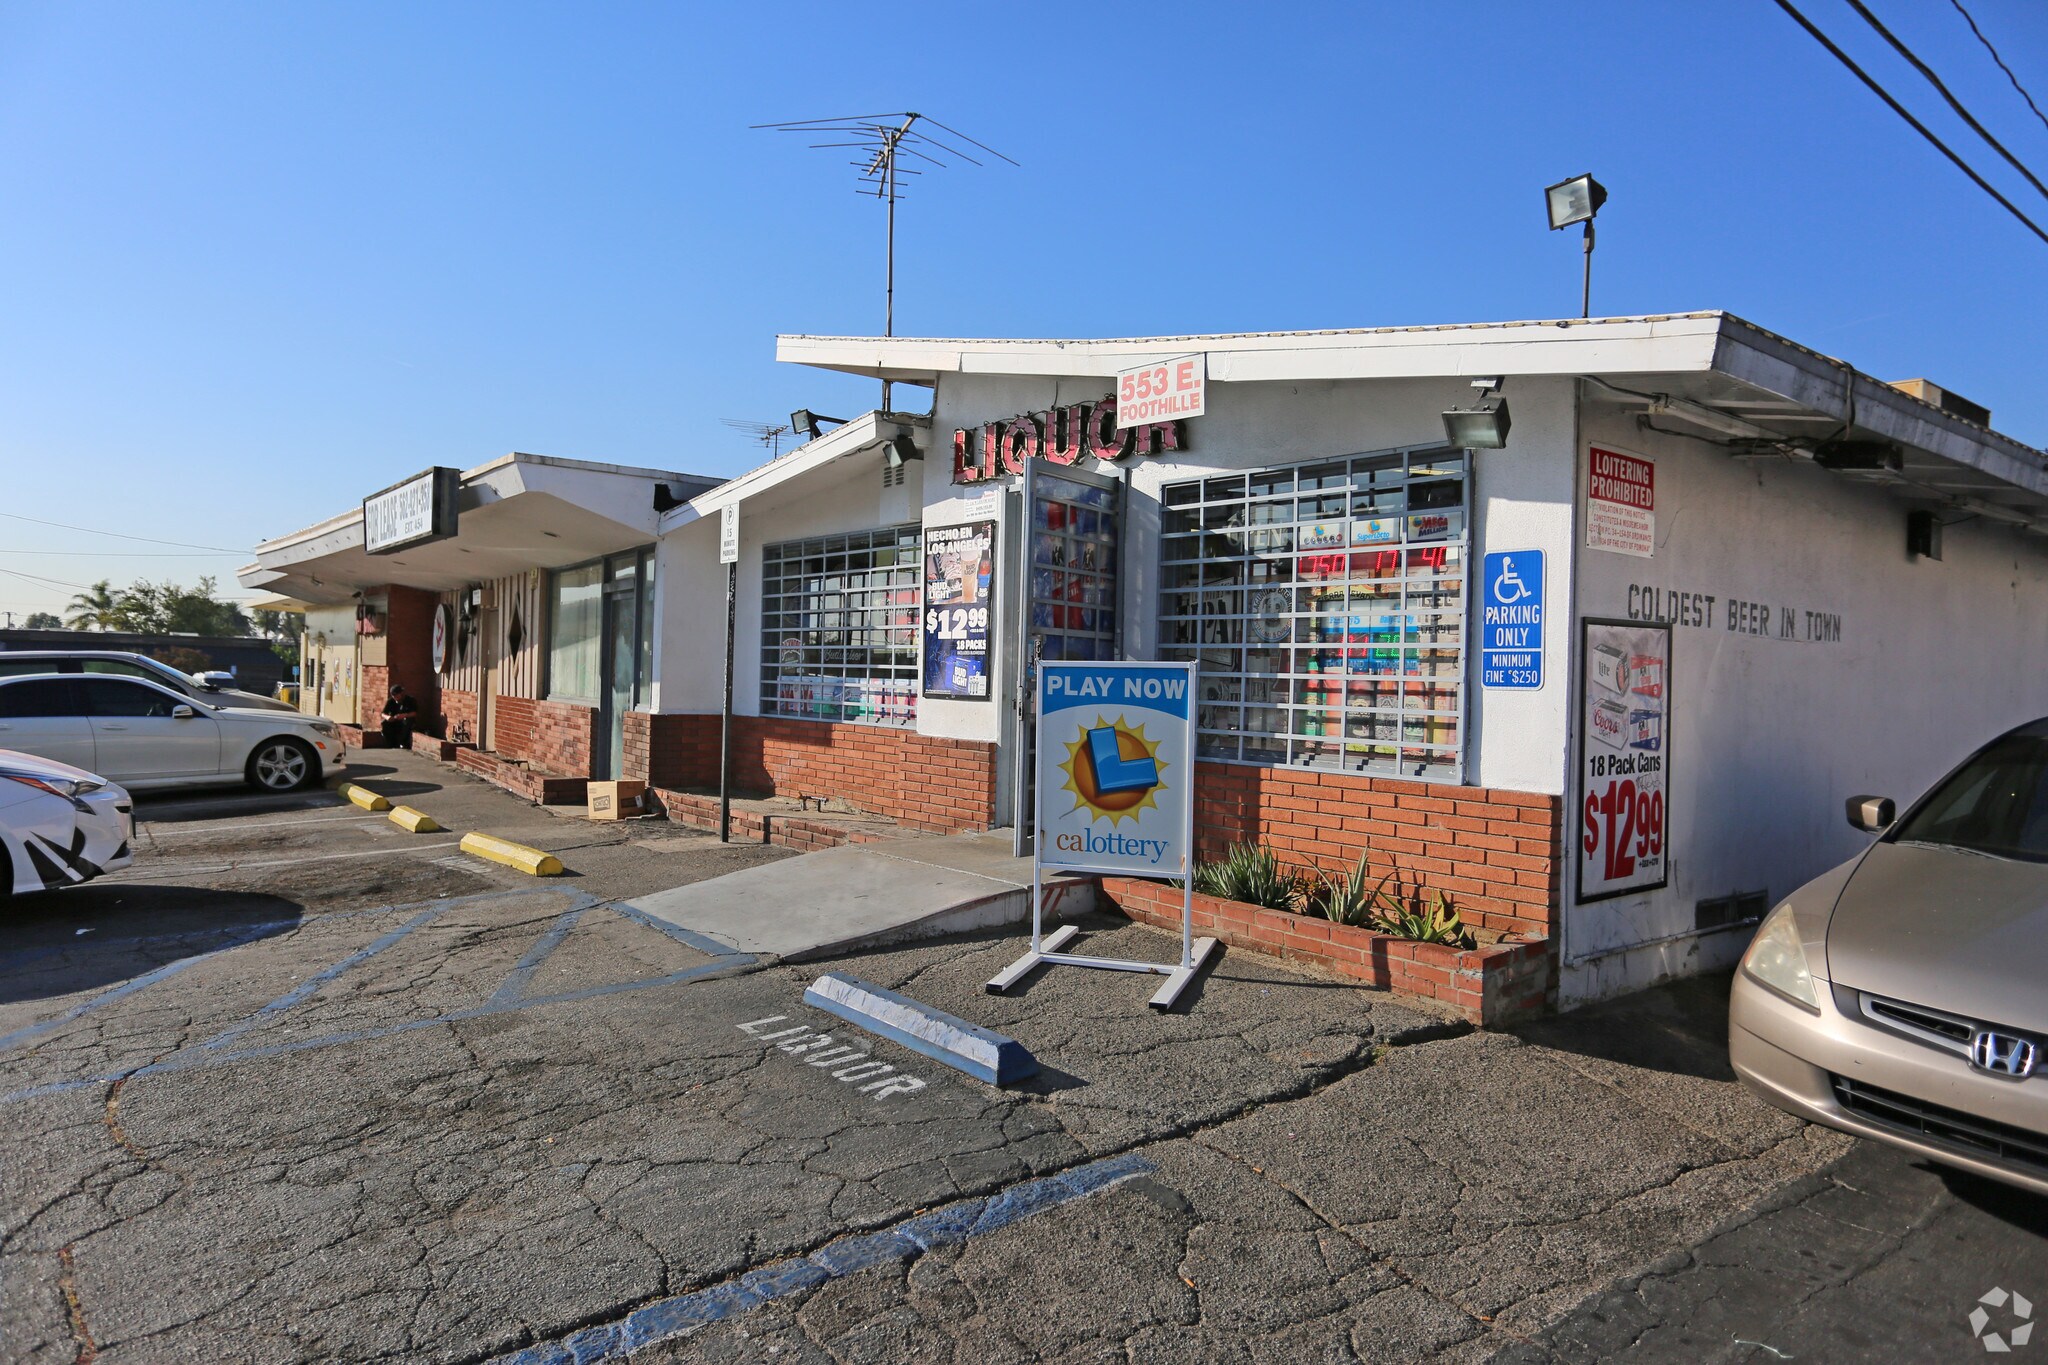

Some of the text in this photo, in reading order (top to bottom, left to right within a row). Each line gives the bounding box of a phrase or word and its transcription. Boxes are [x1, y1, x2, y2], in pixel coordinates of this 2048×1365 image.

[1120, 361, 1200, 402] 553 E.
[1120, 393, 1200, 422] FOOTHILLE
[1596, 453, 1649, 484] LOITERING
[1591, 475, 1653, 506] PROHIBITED
[368, 504, 379, 545] FOR
[380, 495, 397, 541] LEASE
[727, 528, 733, 538] 15
[927, 526, 973, 543] HECHO EN
[927, 537, 990, 555] LOS ANGELES
[928, 589, 951, 599] LIGHT
[931, 582, 949, 591] BUD
[1485, 605, 1540, 624] PARKING
[1628, 583, 1841, 642] COLDEST BEER IN TOWN
[956, 639, 986, 651] 18 PACKS
[1496, 628, 1529, 647] ONLY
[1492, 654, 1531, 667] MINIMUM
[1598, 661, 1611, 677] Lite
[952, 674, 968, 688] LIGHT
[954, 666, 967, 678] BUD
[1486, 669, 1538, 684] FINE $250
[1047, 676, 1186, 700] PLAY NOW
[1594, 709, 1618, 734] Coors
[1590, 752, 1661, 777] 18 Pack Cans
[1056, 827, 1168, 863] calottery
[736, 1015, 927, 1101] LIQUOR
